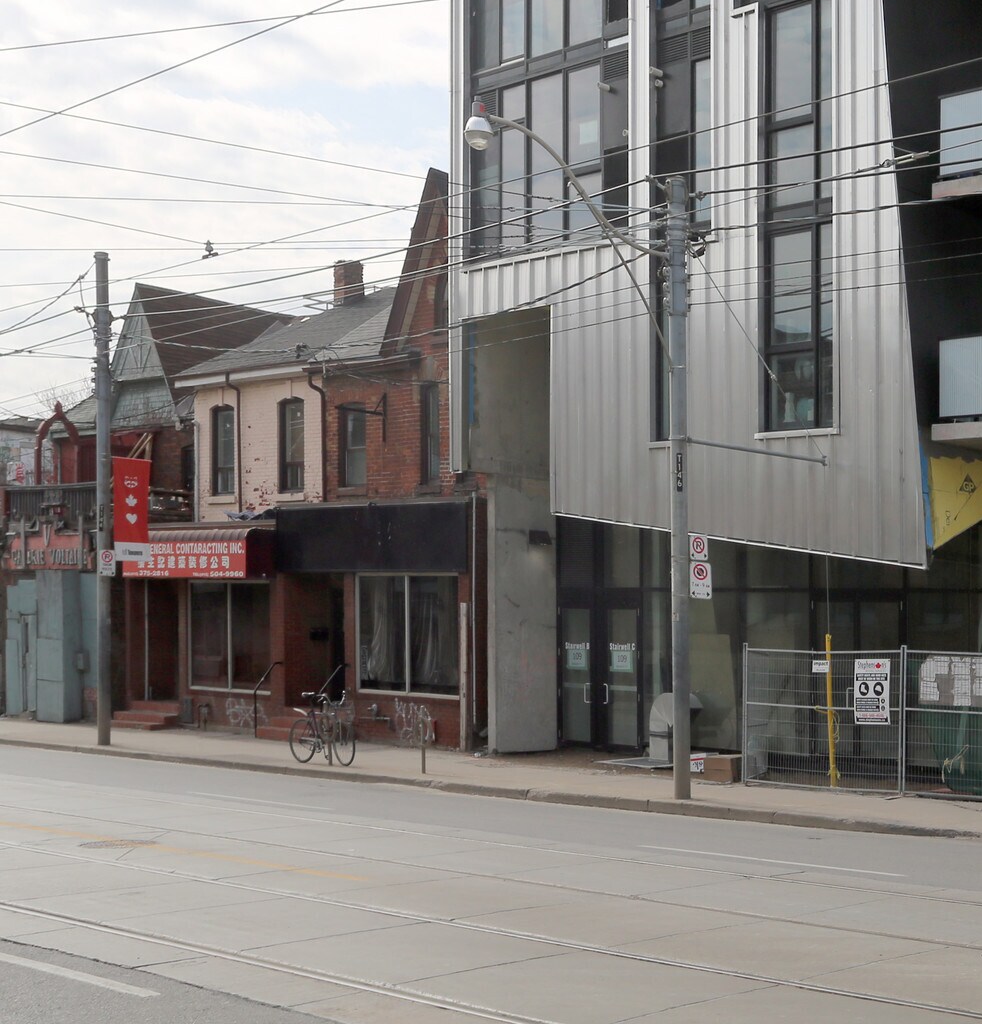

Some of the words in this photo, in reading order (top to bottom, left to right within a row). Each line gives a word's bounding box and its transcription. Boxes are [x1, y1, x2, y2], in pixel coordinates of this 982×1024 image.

[150, 542, 175, 555] ENERAL
[175, 542, 228, 555] CONTARACTING
[229, 541, 245, 554] INC.
[565, 642, 585, 650] Stairwell
[609, 642, 631, 651] Stairwell
[631, 643, 636, 651] C
